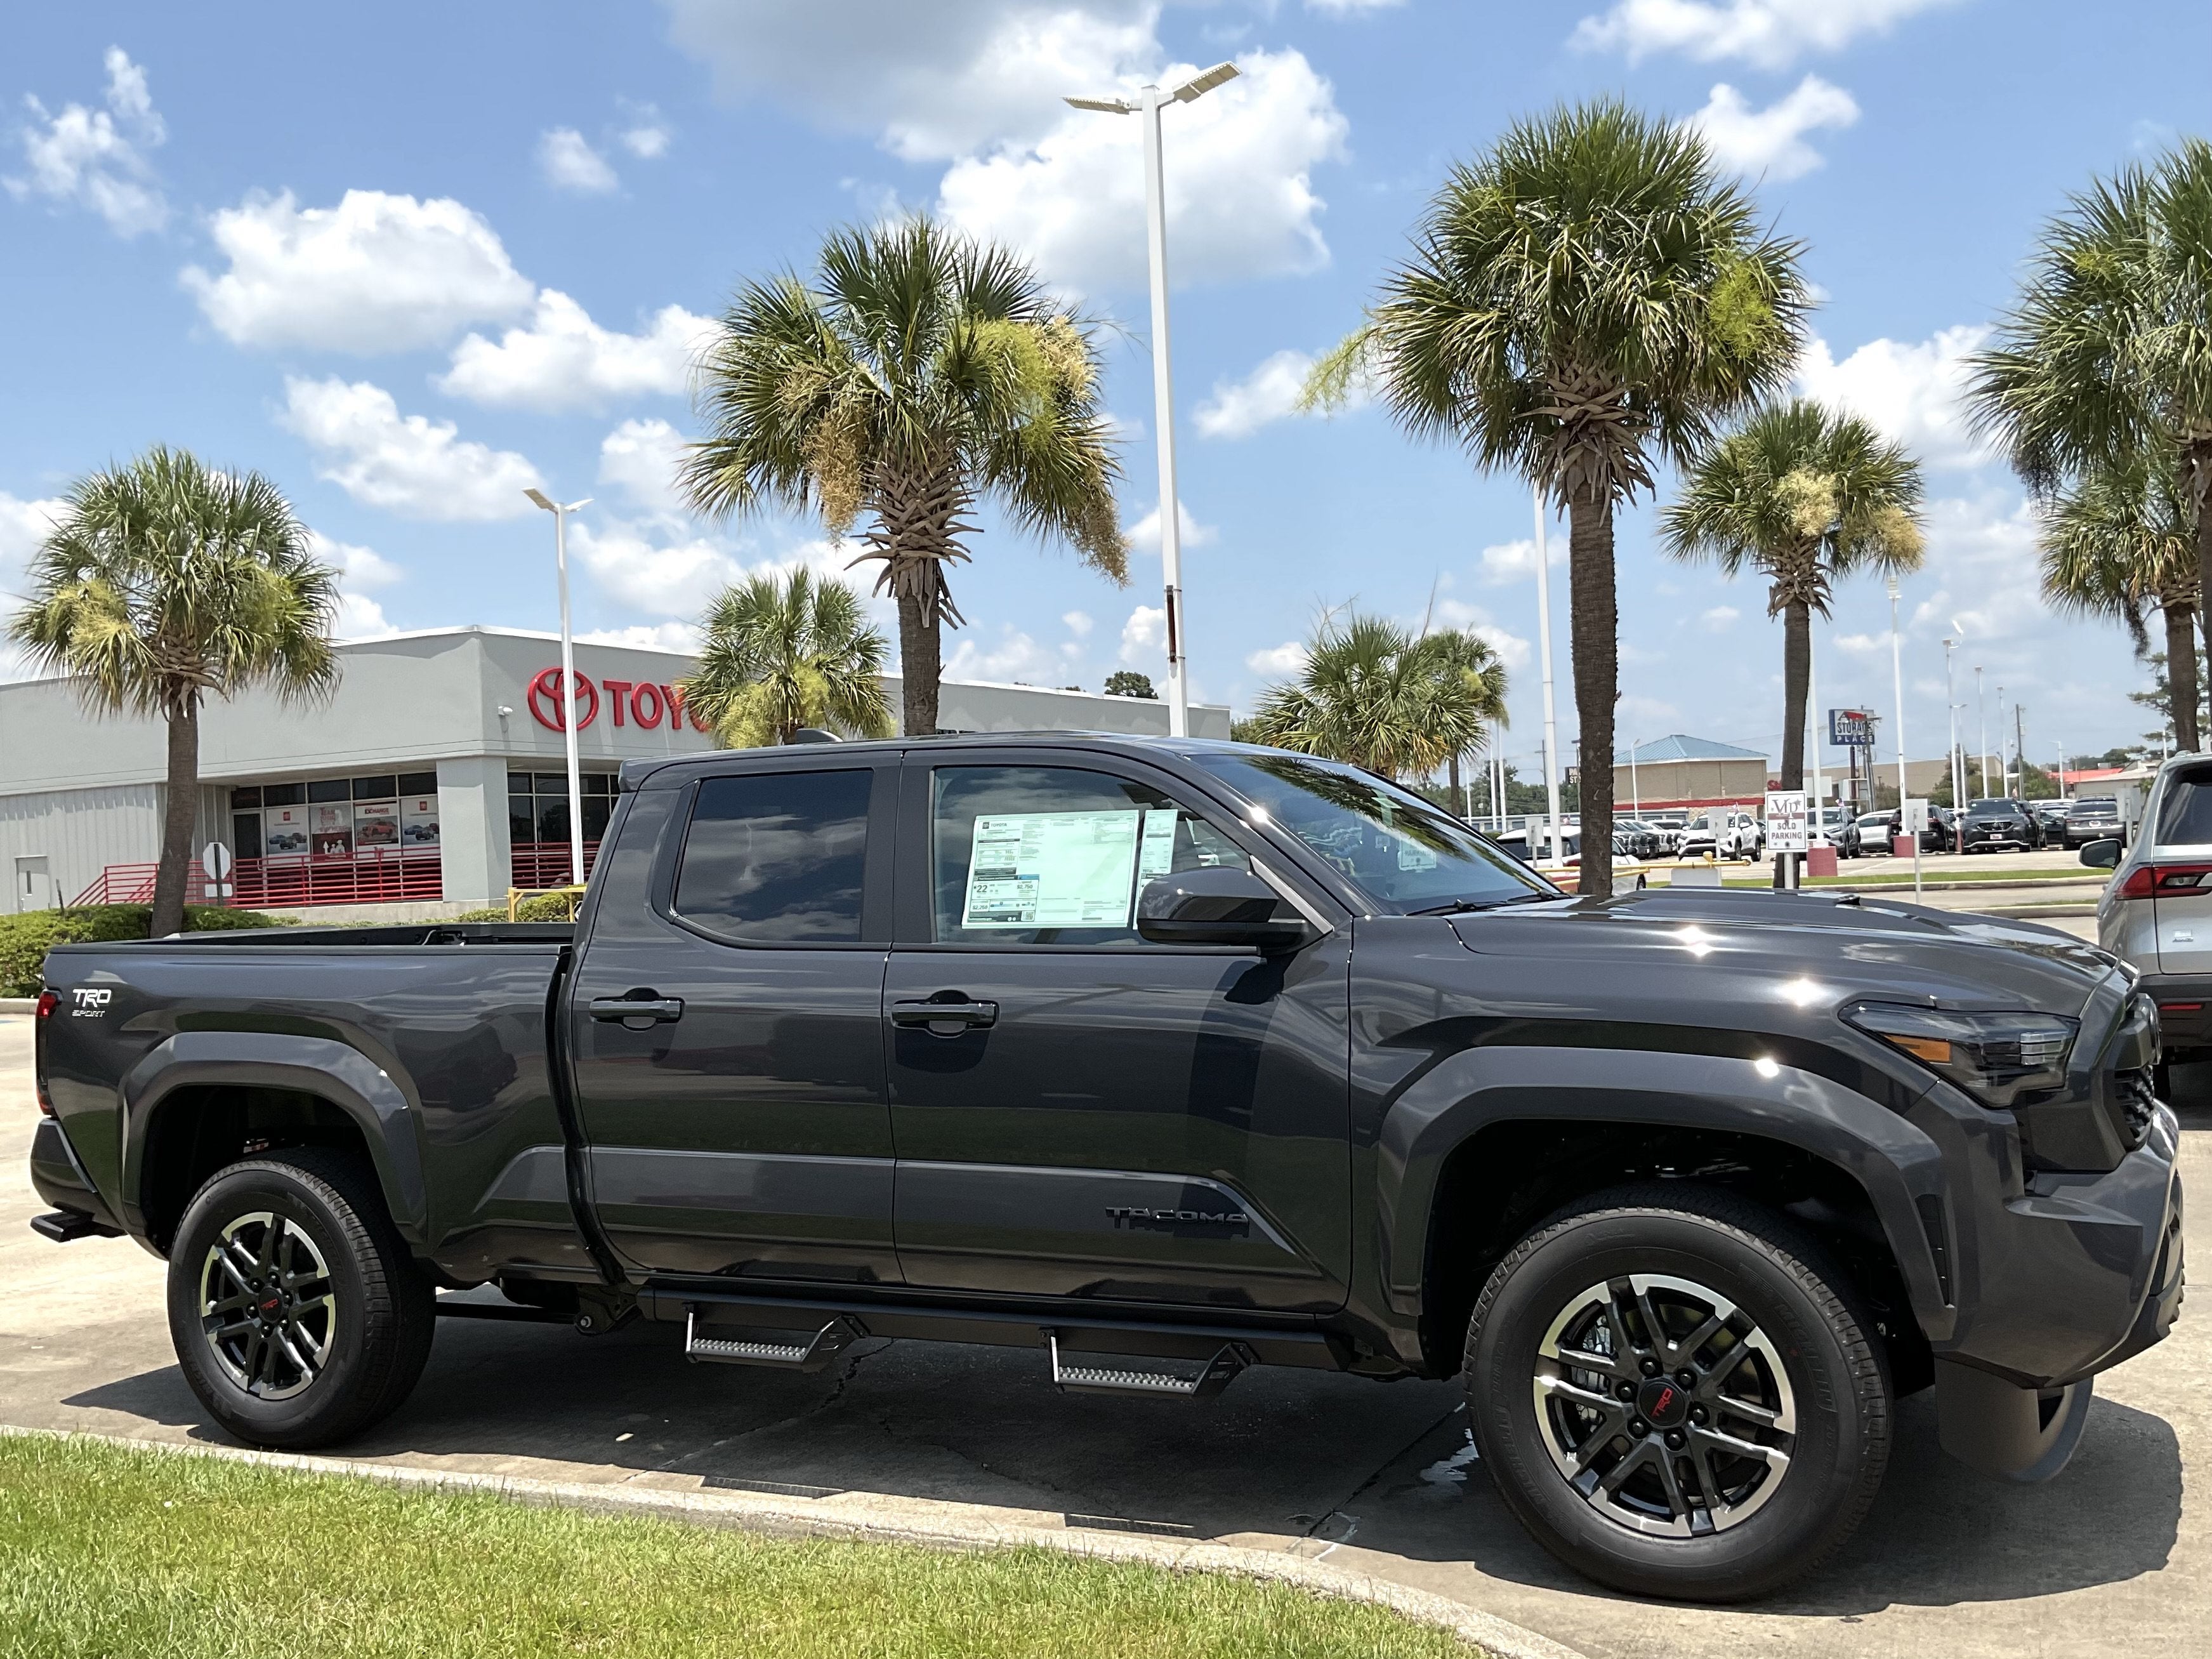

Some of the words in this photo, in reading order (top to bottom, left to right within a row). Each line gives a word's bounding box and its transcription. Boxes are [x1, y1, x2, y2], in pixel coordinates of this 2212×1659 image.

[1771, 831, 1803, 840] PARKING
[977, 885, 988, 893] 22
[72, 988, 112, 1008] TRD
[1105, 1206, 1249, 1226] TACOMA
[1652, 1387, 1673, 1417] TRD
